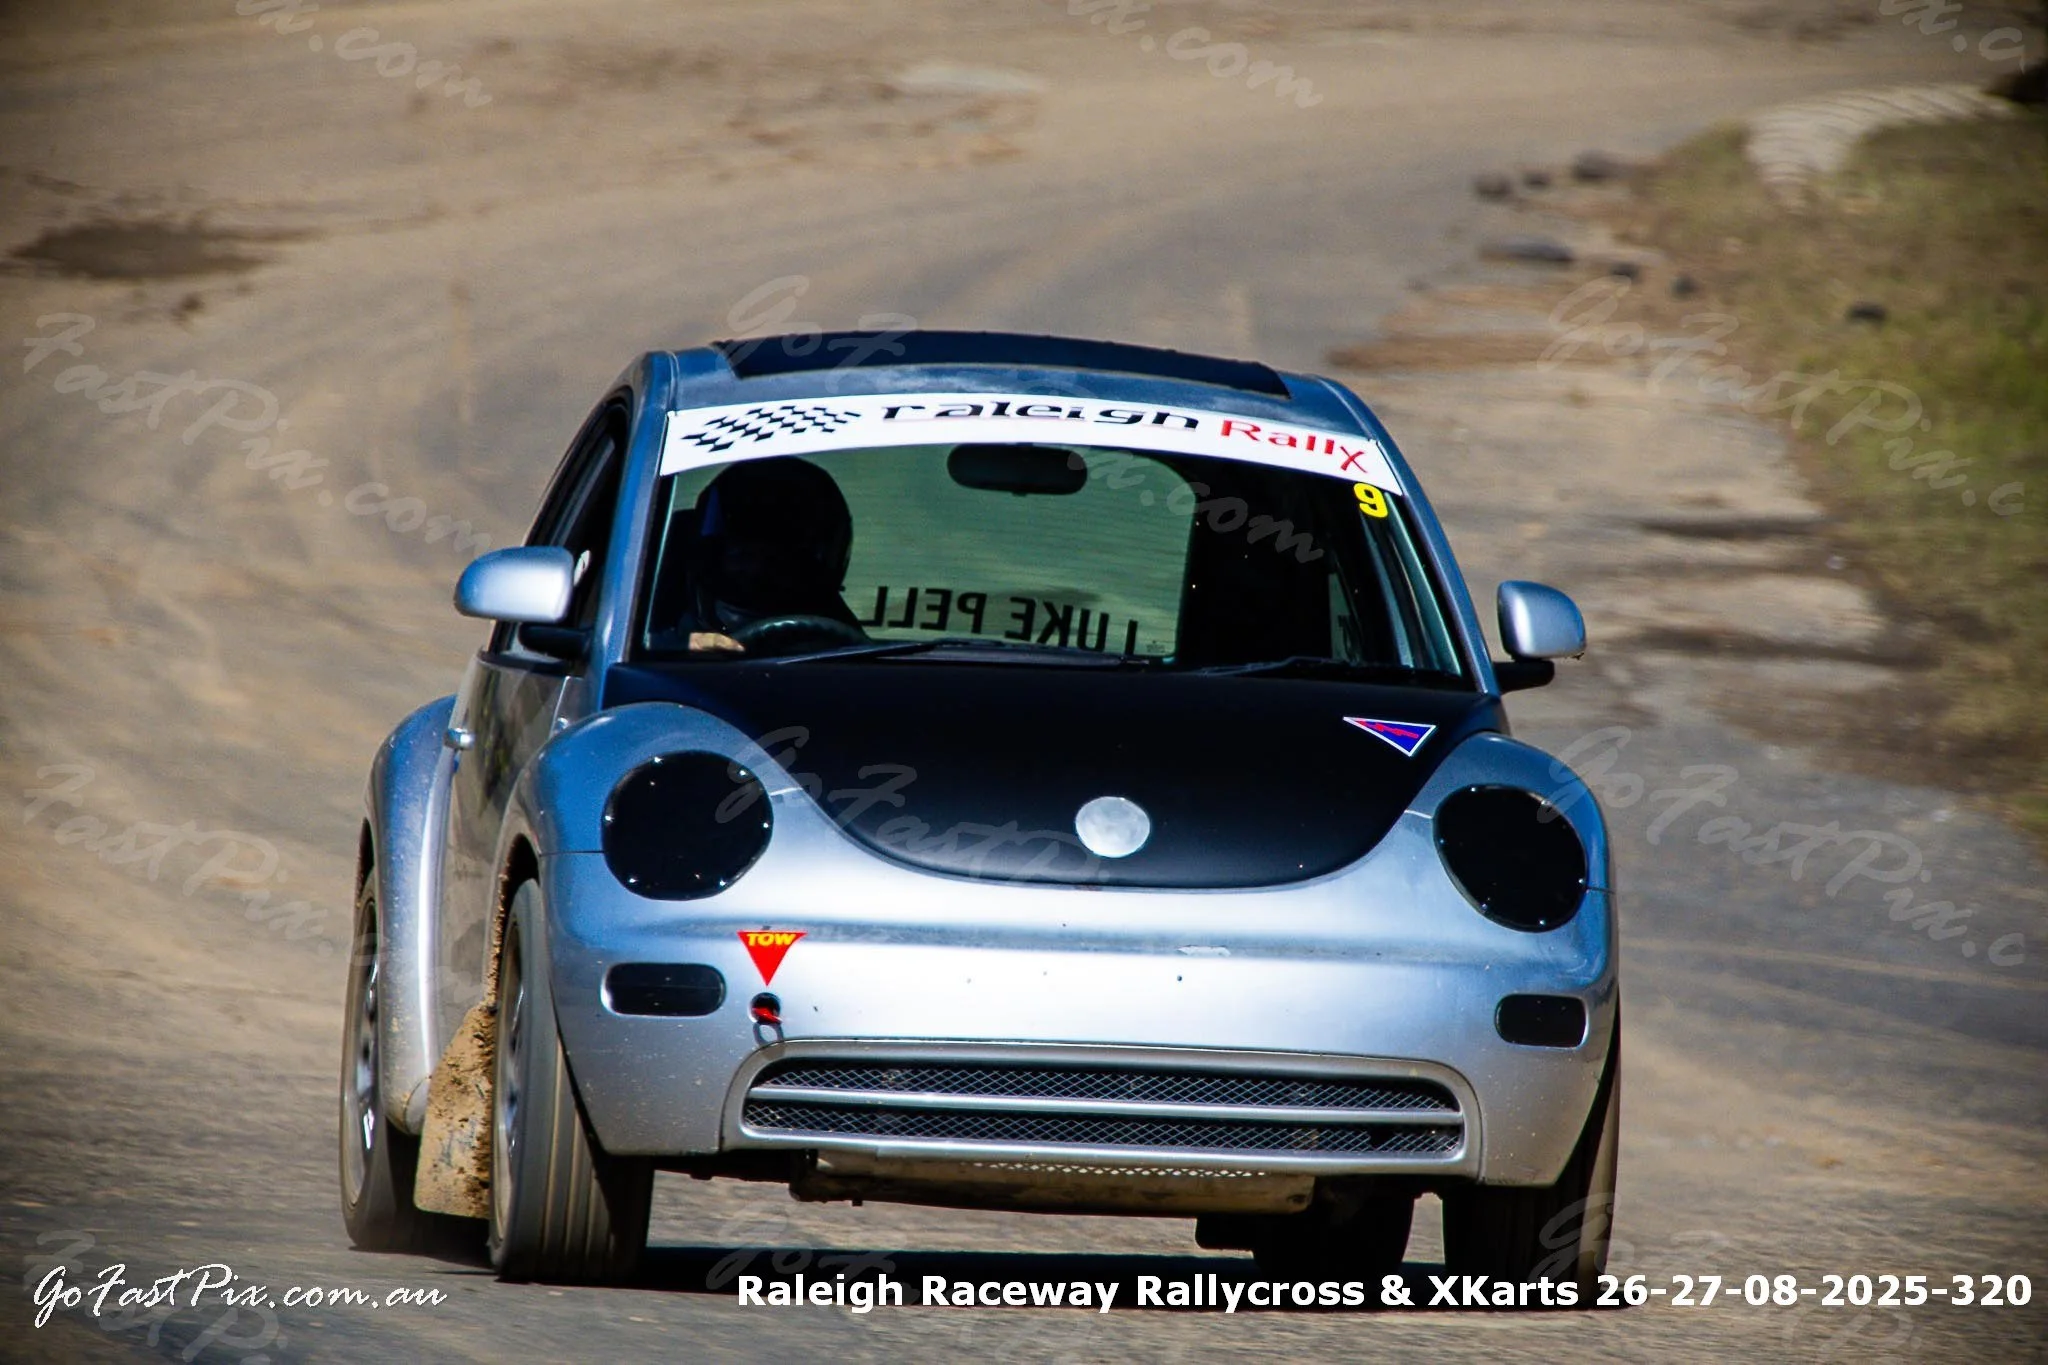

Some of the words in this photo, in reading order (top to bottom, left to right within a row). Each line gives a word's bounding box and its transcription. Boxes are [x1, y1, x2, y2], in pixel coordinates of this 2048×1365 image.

[882, 400, 1199, 431] raleigh
[1353, 482, 1388, 519] 9
[746, 933, 797, 947] TOW
